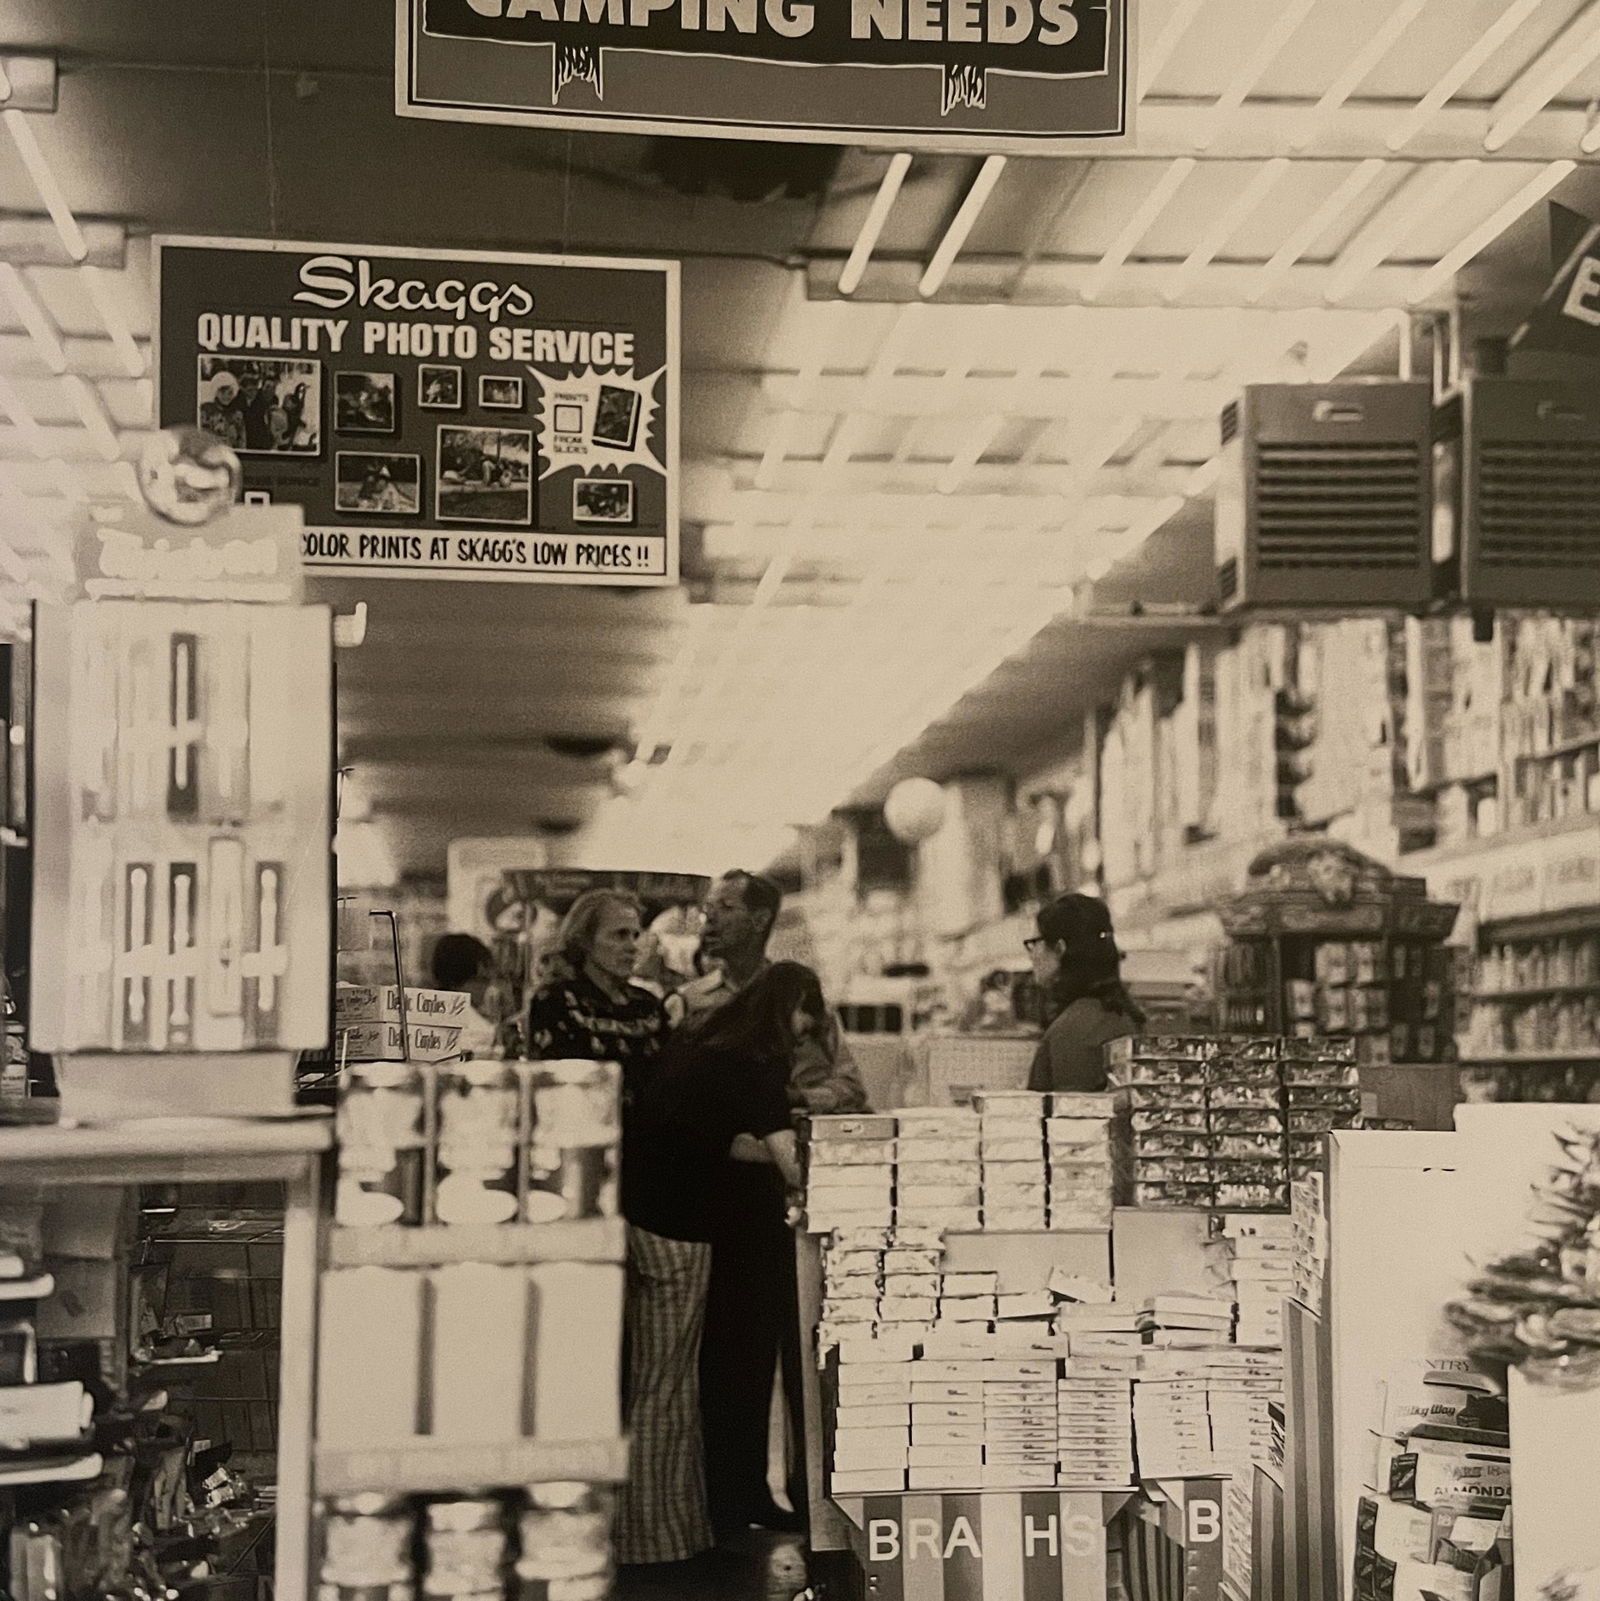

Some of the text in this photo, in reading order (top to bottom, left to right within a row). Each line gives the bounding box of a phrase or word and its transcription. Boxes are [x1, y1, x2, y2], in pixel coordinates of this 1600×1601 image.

[850, 0, 1079, 46] NEEDS
[293, 255, 534, 322] Skaggs
[197, 313, 635, 366] QUALITY PHOTO SERVICE
[359, 534, 422, 559] PRINTS
[430, 537, 450, 560] AT
[457, 538, 526, 564] SKAGG'S
[534, 541, 568, 565] LOW
[1430, 1403, 1456, 1415] Way
